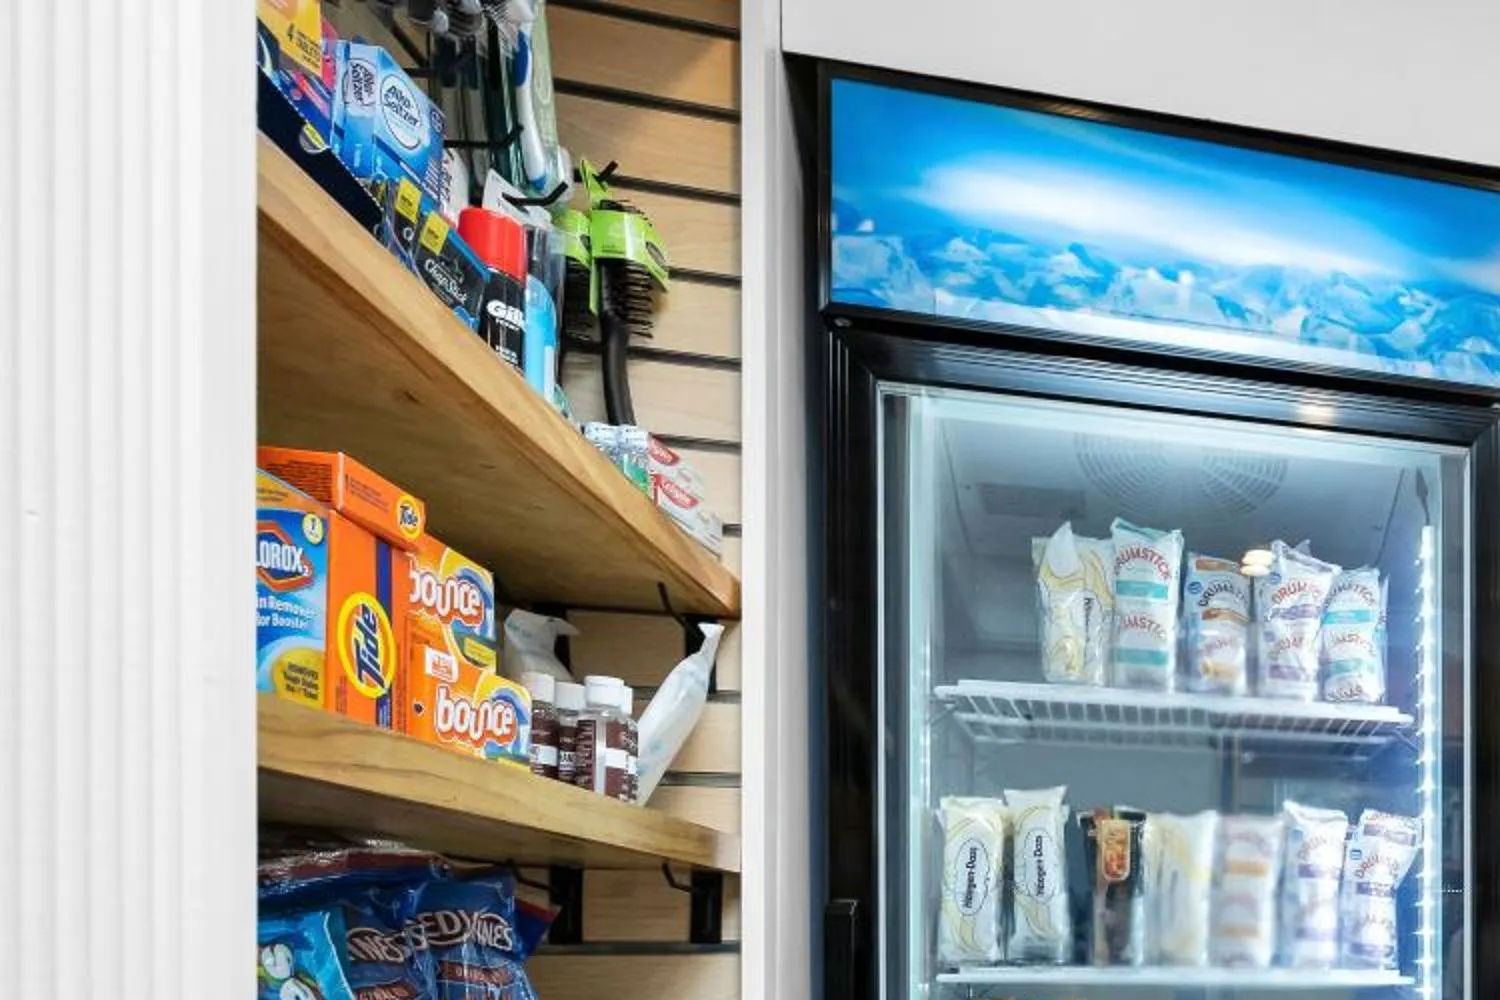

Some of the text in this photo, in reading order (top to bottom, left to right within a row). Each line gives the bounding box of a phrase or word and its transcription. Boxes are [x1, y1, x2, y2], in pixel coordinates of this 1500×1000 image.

[400, 505, 418, 527] Tide
[256, 541, 303, 573] OROX
[352, 603, 387, 689] Tide
[436, 685, 515, 741] bounce
